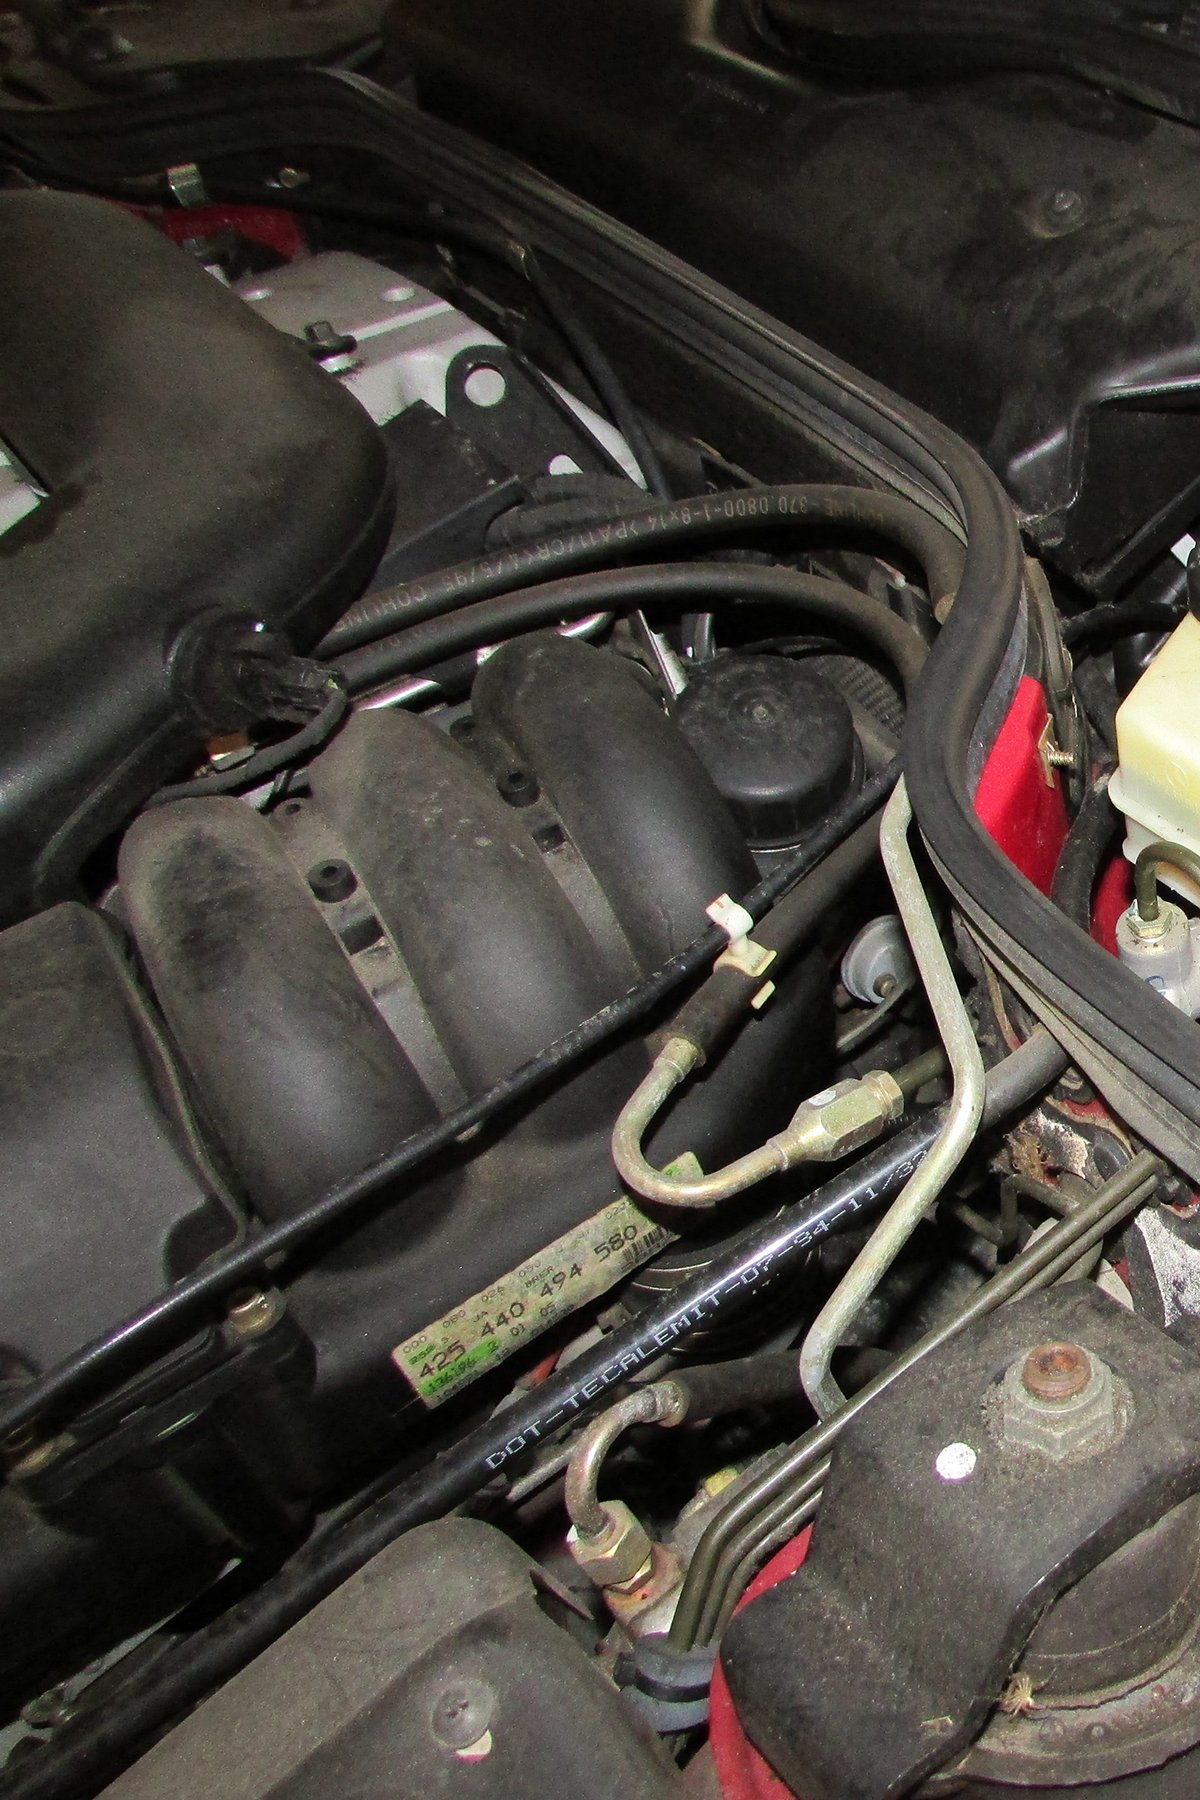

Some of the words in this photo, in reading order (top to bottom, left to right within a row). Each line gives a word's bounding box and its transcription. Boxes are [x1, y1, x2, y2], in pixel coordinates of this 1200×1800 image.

[418, 1343, 465, 1377] 425
[479, 1302, 525, 1336] 440
[538, 1263, 582, 1296] 494
[593, 1225, 638, 1262] 580
